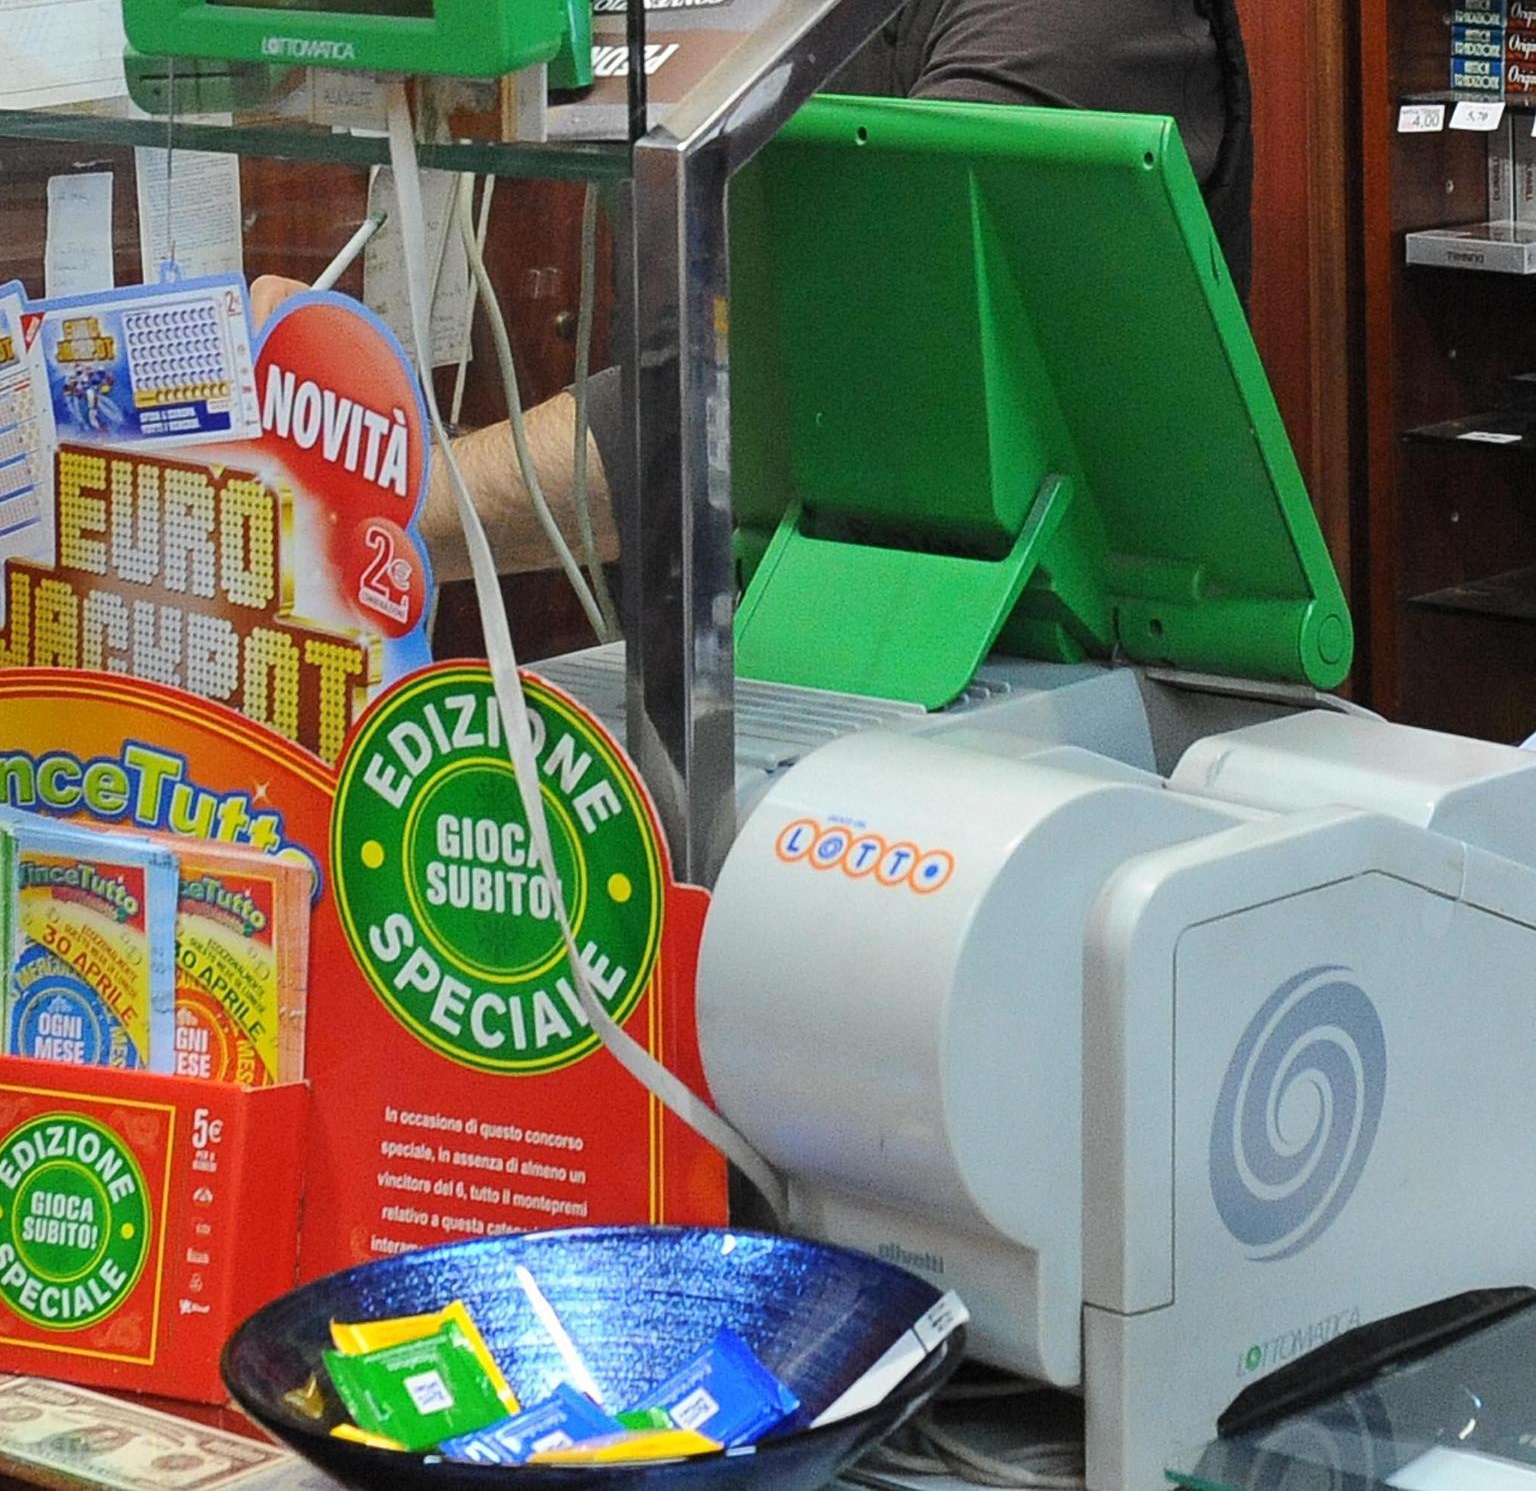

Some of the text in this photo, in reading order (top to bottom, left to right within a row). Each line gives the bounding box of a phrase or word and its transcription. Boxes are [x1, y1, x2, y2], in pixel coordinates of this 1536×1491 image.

[261, 36, 355, 59] LOTTOMATICA
[262, 364, 409, 498] NOVITÀ
[58, 452, 276, 609] EURO
[774, 816, 955, 895] LOTTO
[41, 923, 139, 1027] 30 APRILE
[37, 1012, 83, 1040] OGNI
[198, 966, 267, 1043] APRILE
[34, 1036, 86, 1064] MESE
[191, 1108, 224, 1149] 5€
[385, 1106, 584, 1151] In occasione di questo concorso
[381, 1140, 586, 1185] speciale, in assenza di almeno un
[30, 1190, 96, 1223] GIOCA
[377, 1170, 432, 1193] vincitore
[433, 1177, 453, 1196] del
[470, 1184, 500, 1204] tutto
[502, 1189, 510, 1205] il
[512, 1192, 588, 1217] montepremi
[21, 1215, 98, 1252] SUBITO!
[381, 1205, 429, 1226] relativo
[430, 1213, 439, 1227] a
[441, 1214, 484, 1235] questa
[878, 1242, 946, 1274] olivetti
